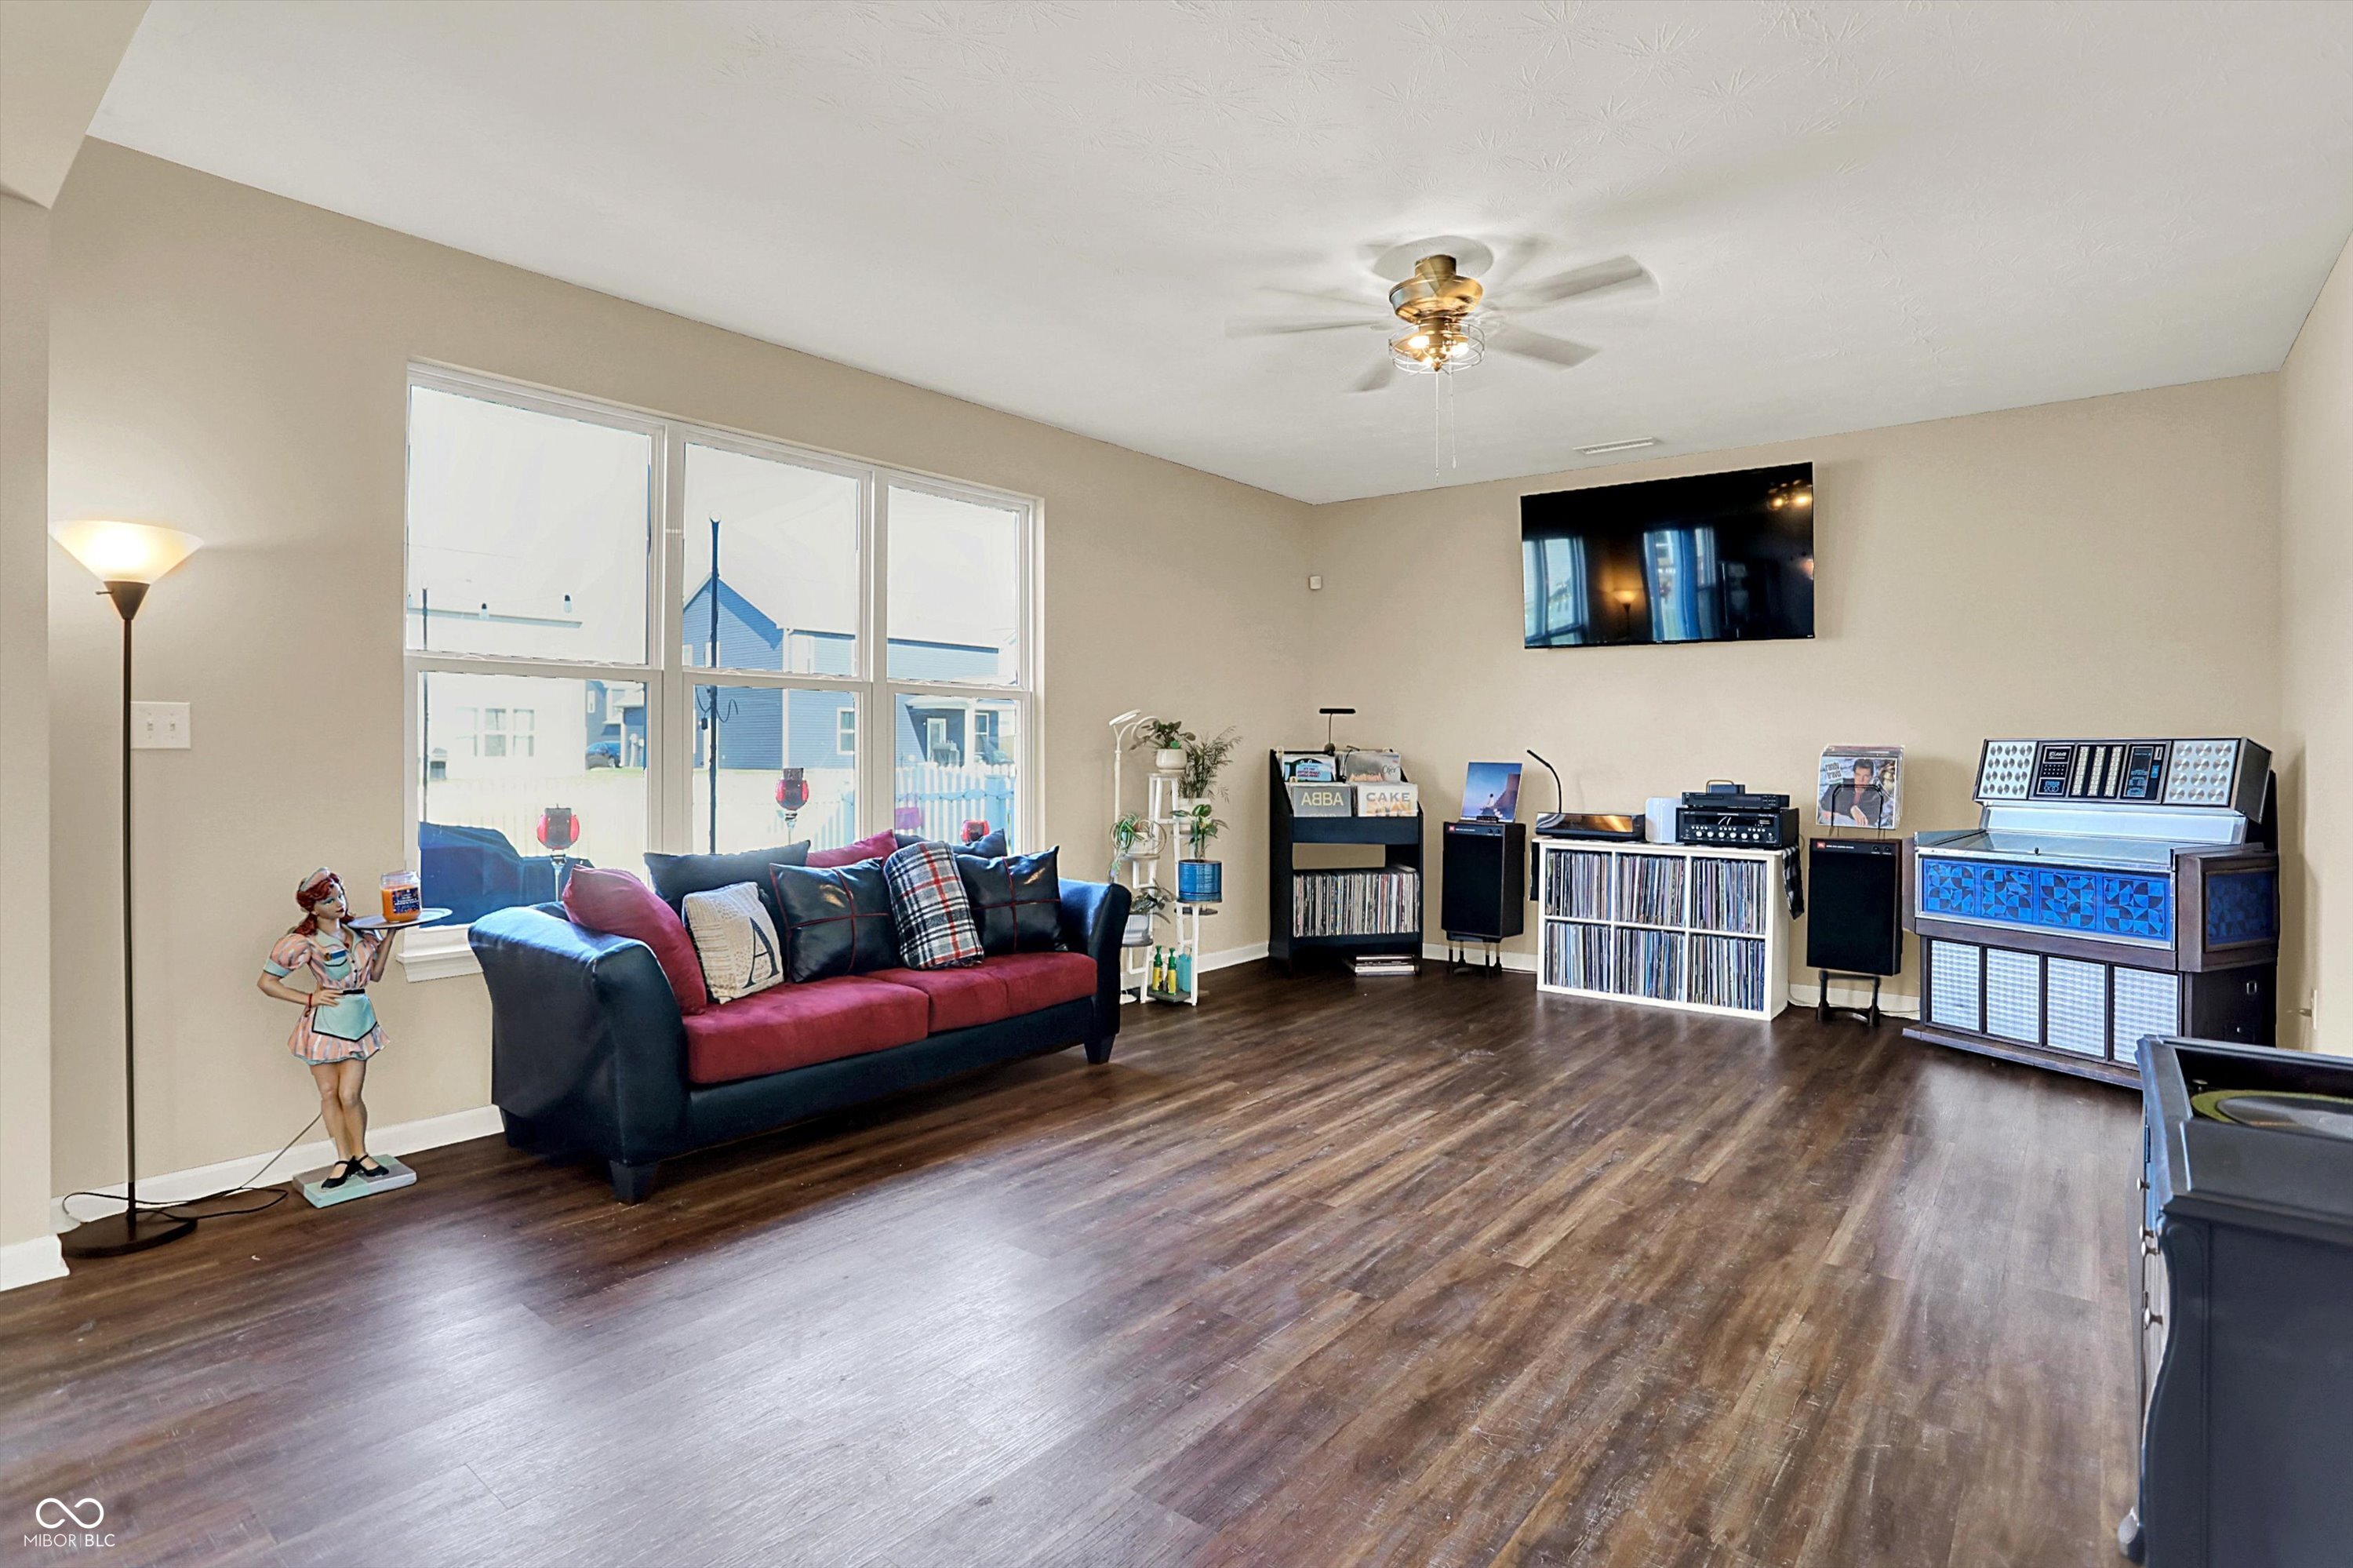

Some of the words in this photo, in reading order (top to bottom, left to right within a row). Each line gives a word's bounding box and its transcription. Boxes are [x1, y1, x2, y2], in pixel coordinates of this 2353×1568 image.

[1300, 791, 1344, 806] ABBA
[1366, 792, 1410, 802] CAKE
[741, 916, 780, 989] A
